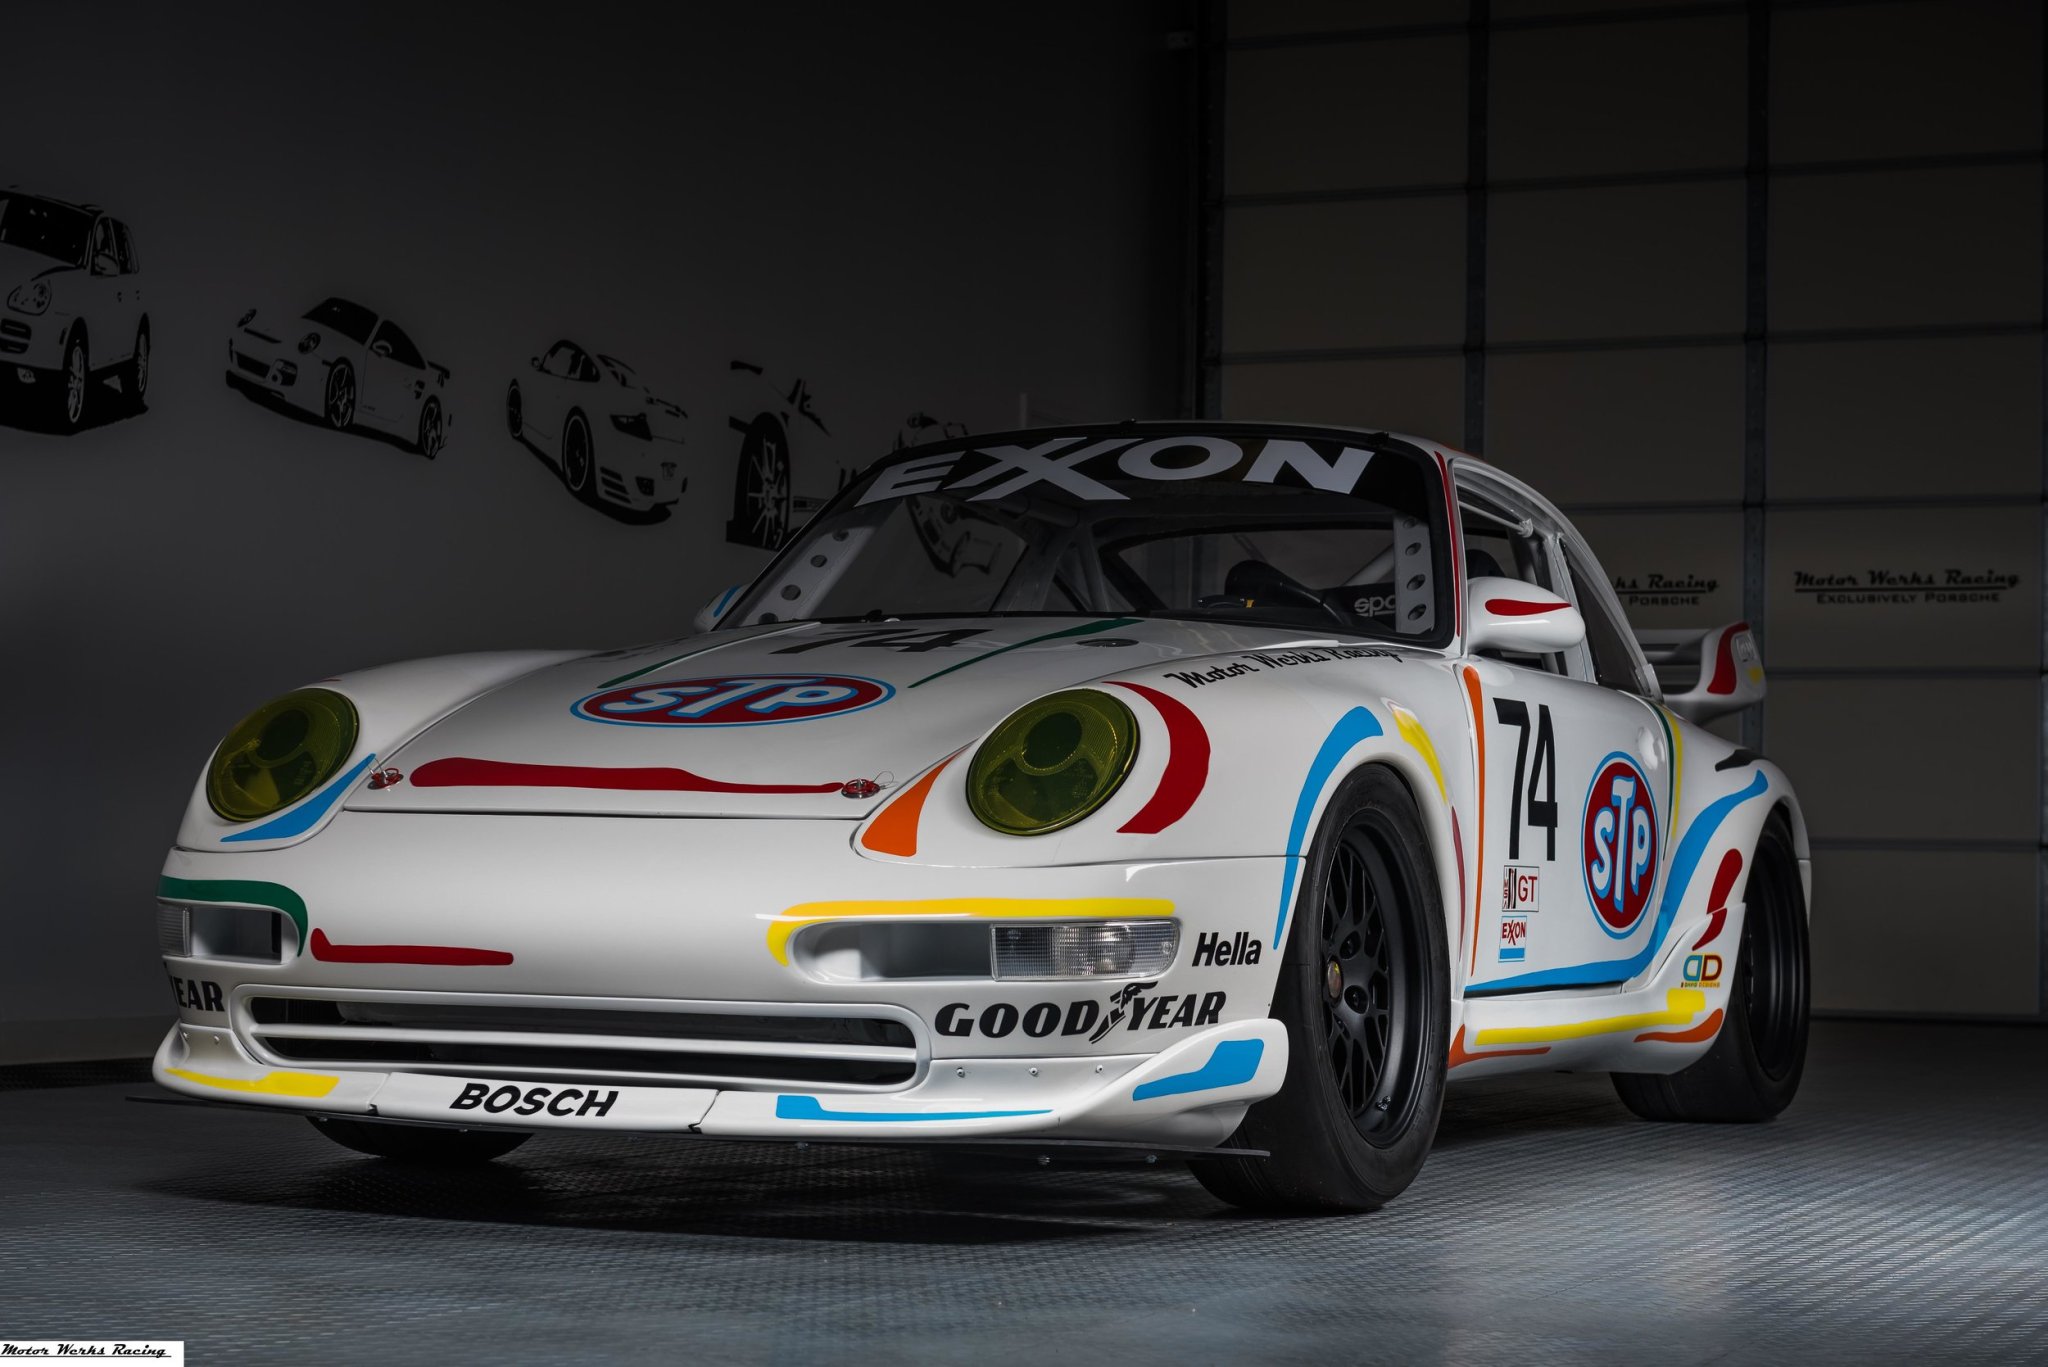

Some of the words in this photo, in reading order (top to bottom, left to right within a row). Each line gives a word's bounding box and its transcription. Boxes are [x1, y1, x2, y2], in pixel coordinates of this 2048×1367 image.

[854, 435, 1377, 508] EXXON
[1648, 574, 1718, 593] Racing
[1794, 571, 1858, 587] Motor
[1868, 569, 1935, 586] Werks
[1945, 568, 2019, 588] Racing
[769, 628, 993, 655] 74
[1163, 662, 1260, 689] Motor
[1242, 647, 1331, 669] Werks
[599, 677, 860, 719] STP
[1493, 697, 1558, 861] 74
[1591, 775, 1651, 913] STP
[1517, 875, 1538, 902] GT
[1192, 932, 1262, 967] Hella
[1502, 920, 1527, 946] EXXON
[449, 1082, 619, 1117] BOSCH
